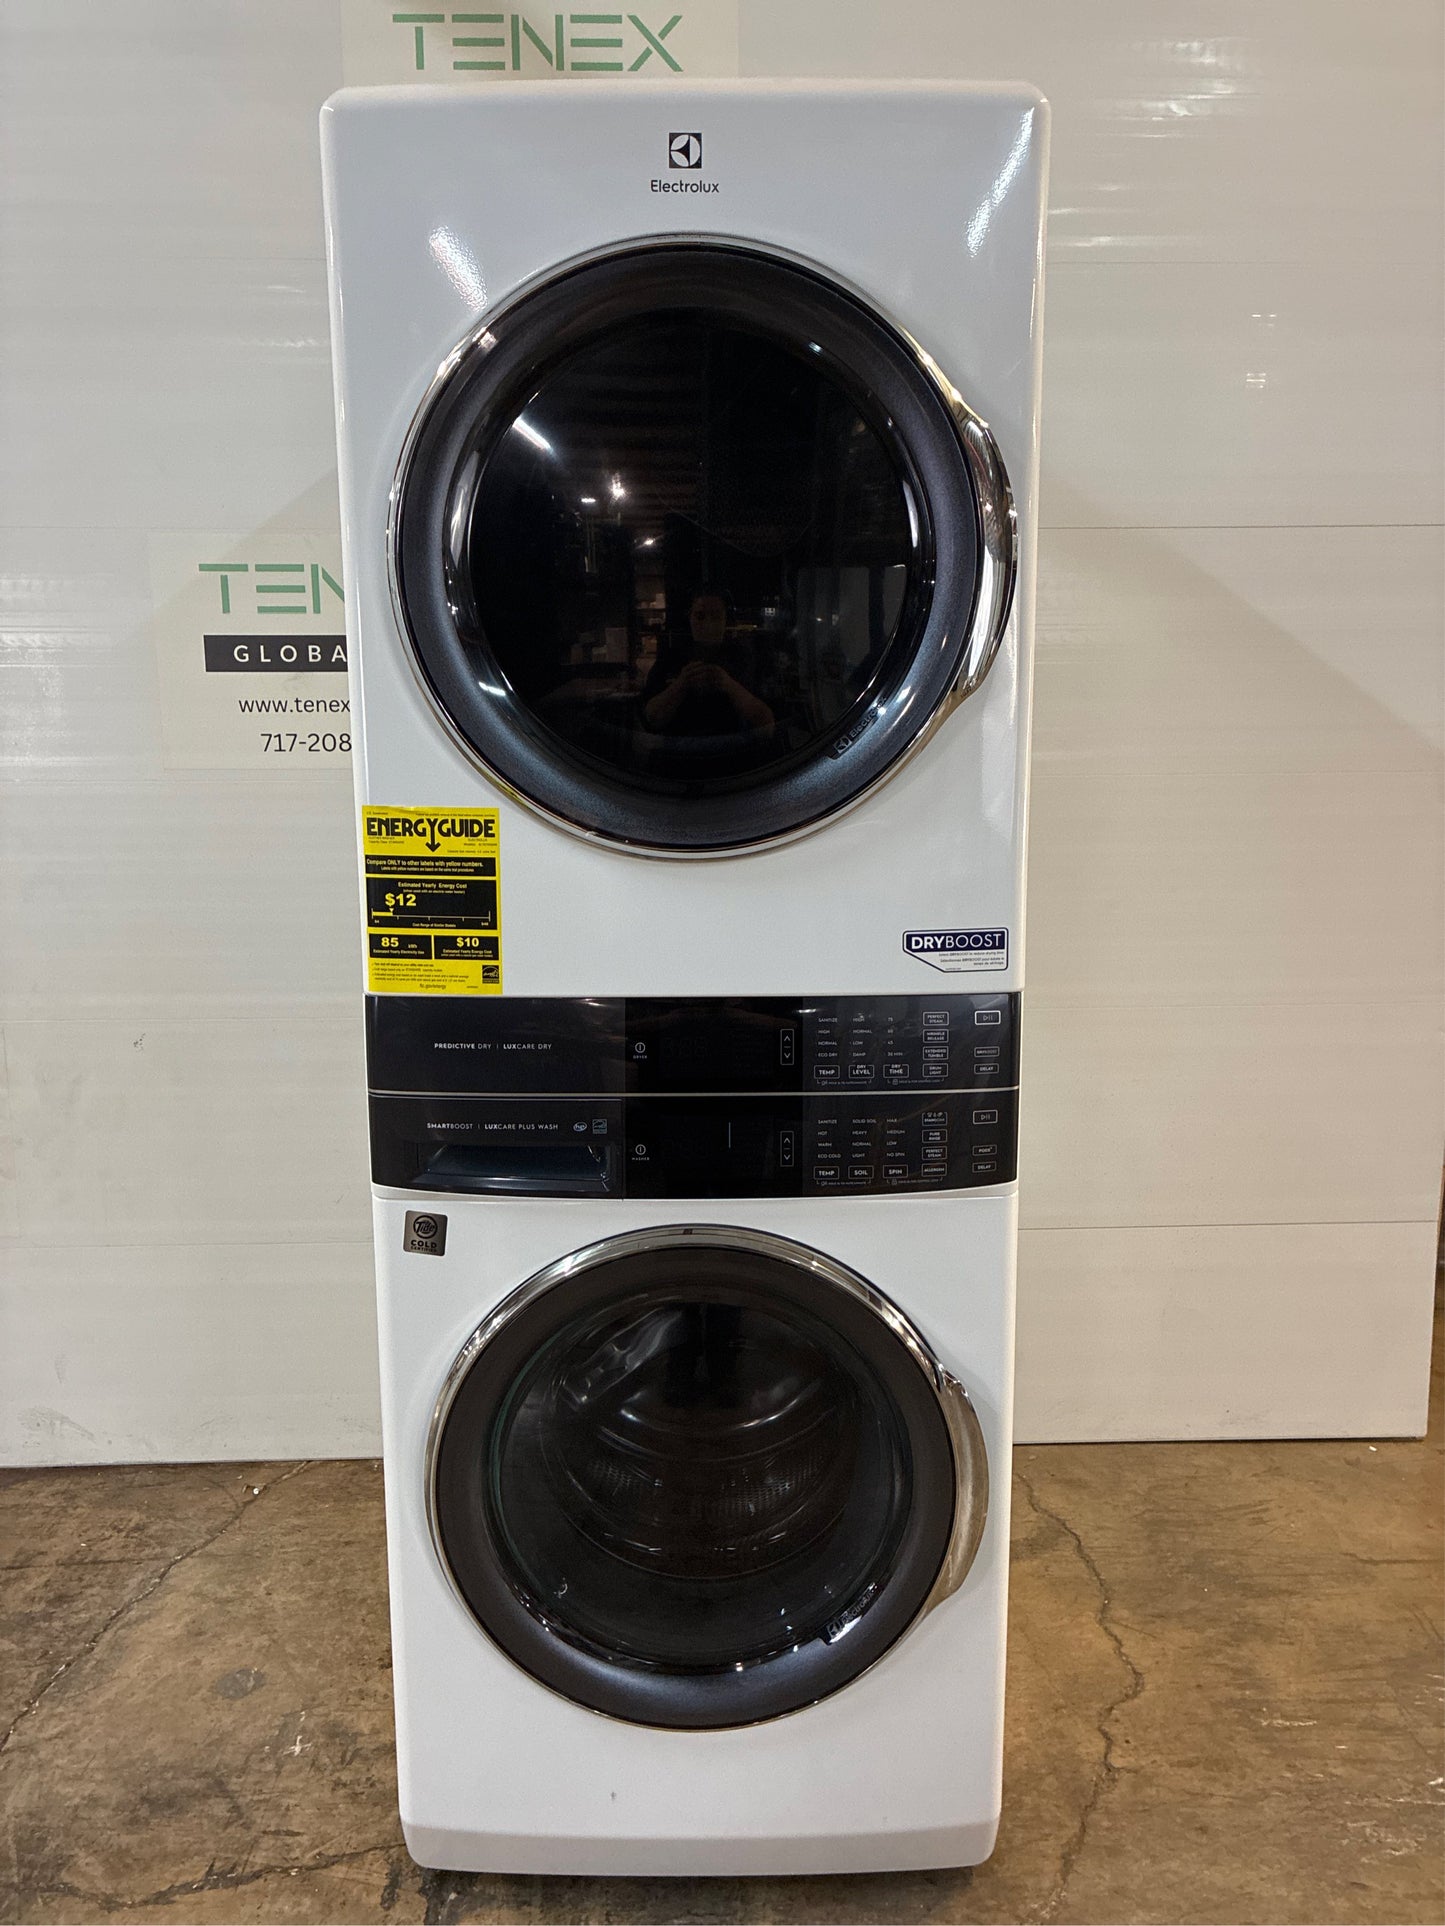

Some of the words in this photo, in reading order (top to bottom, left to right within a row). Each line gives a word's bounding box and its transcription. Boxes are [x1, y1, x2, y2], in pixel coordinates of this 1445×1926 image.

[393, 14, 683, 72] TENEX
[650, 179, 720, 193] Electrolux
[233, 645, 347, 662] GLOBA
[239, 698, 350, 713] www.tenex
[261, 734, 352, 752] 717-208
[366, 818, 496, 839] ENERGYGUIDE
[367, 858, 386, 866] Compare
[385, 893, 416, 907] $12
[381, 937, 399, 947] 85
[456, 937, 479, 948] $10
[911, 934, 1002, 949] DRYBOOST
[416, 1220, 435, 1233] Tide
[411, 1240, 437, 1248] COLD
